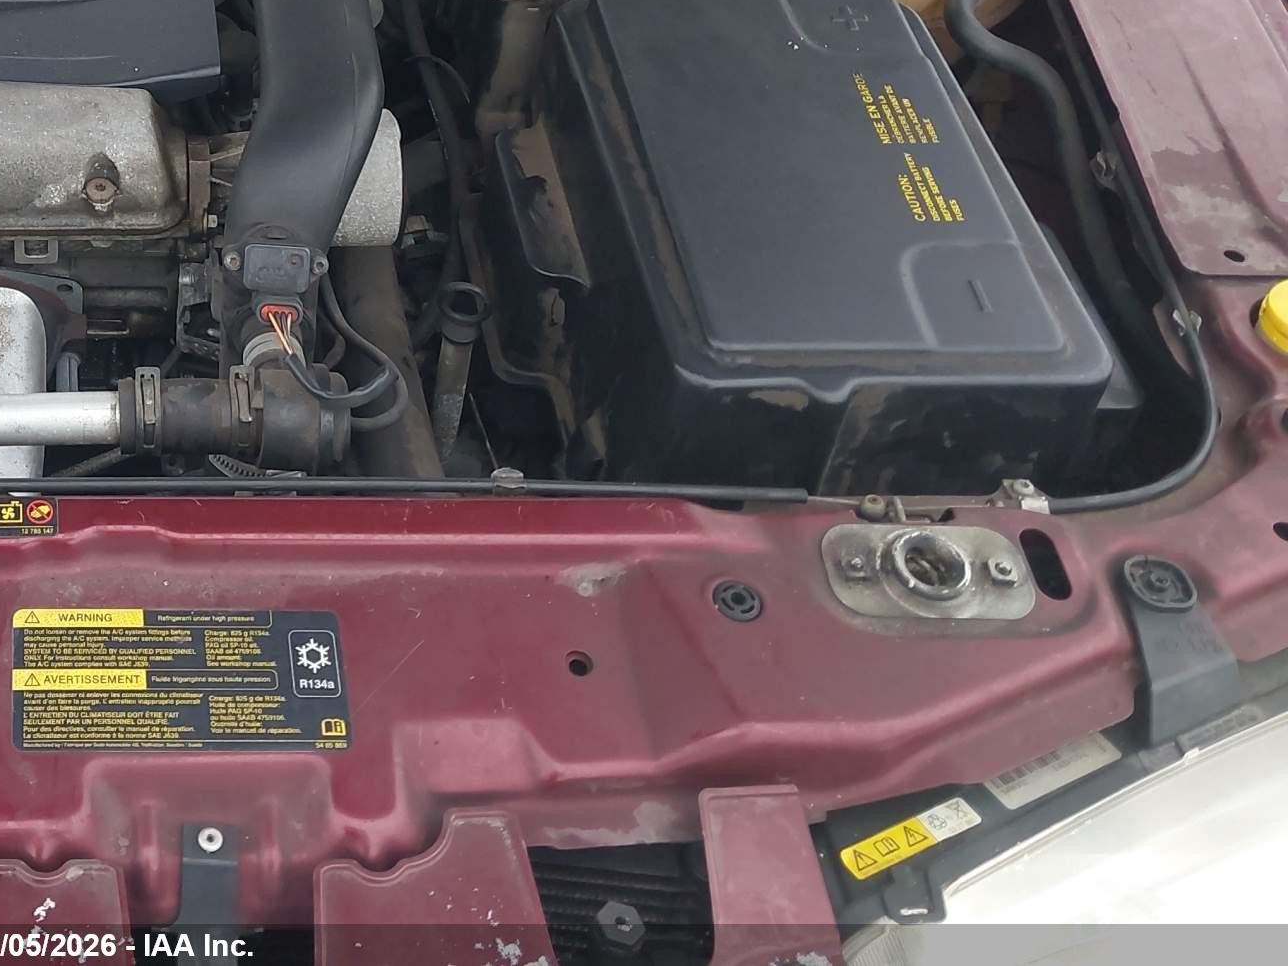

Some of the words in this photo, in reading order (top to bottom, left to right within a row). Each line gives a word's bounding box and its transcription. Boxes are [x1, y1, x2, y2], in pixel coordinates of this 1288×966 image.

[852, 73, 874, 103] GARDE
[866, 104, 881, 119] EN
[889, 93, 903, 114] AVANT
[874, 121, 892, 144] MISE
[898, 115, 917, 144] BATTERIE
[904, 152, 923, 182] BATTERY
[898, 173, 926, 222] CAUTION:
[917, 182, 941, 222] DISCONNECT
[935, 195, 953, 222] BEFORE
[949, 199, 965, 222] FUSES
[58, 614, 112, 622] WARNING
[43, 675, 140, 684] AVERTISSEMENT
[299, 680, 335, 688] R134a
